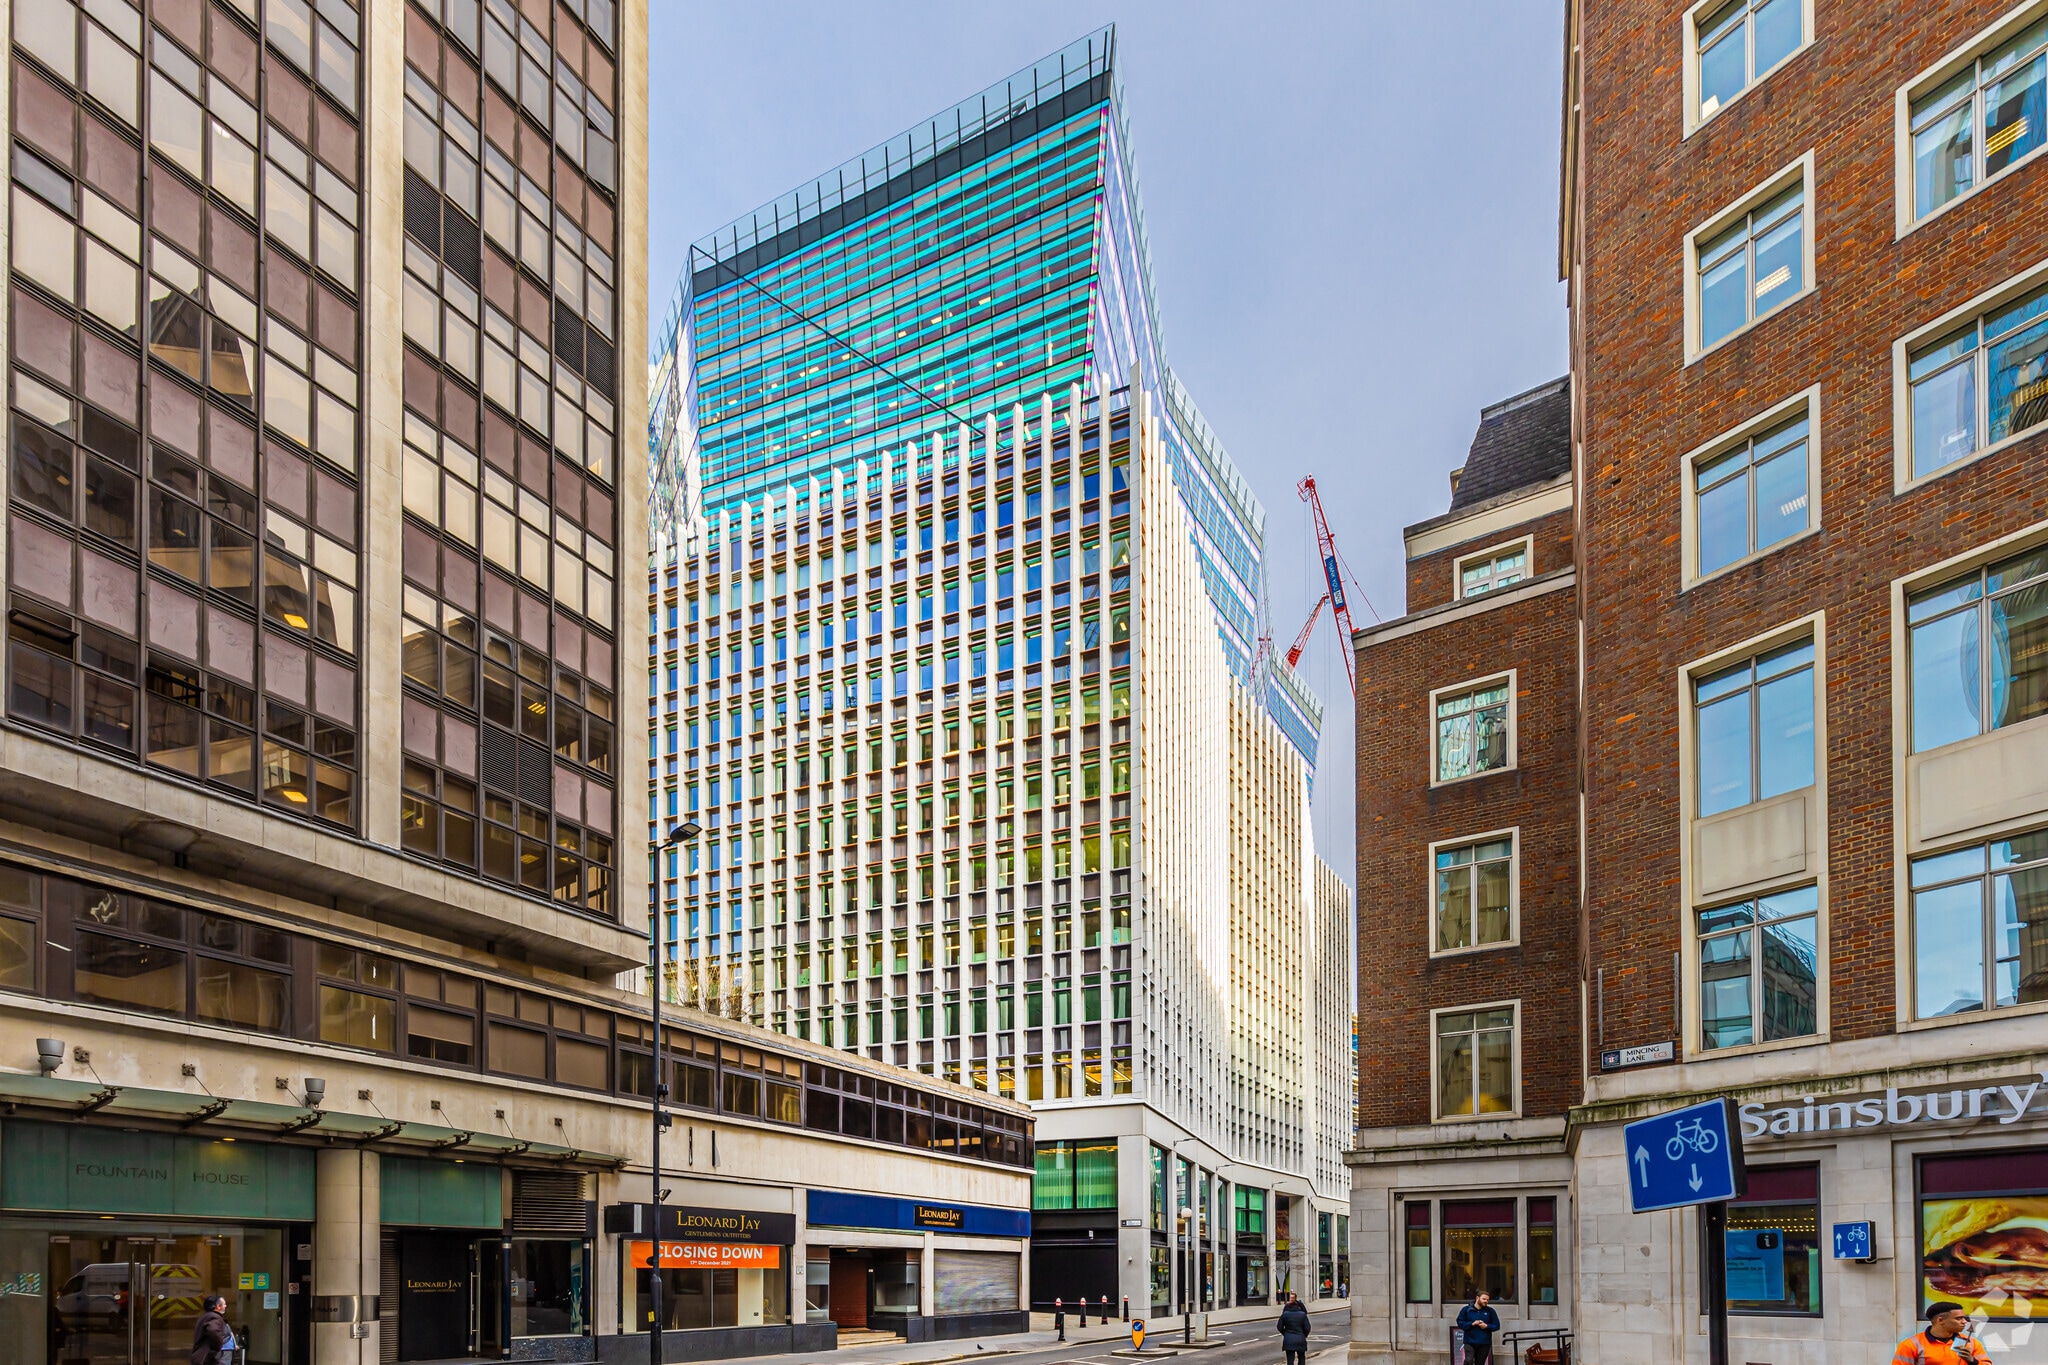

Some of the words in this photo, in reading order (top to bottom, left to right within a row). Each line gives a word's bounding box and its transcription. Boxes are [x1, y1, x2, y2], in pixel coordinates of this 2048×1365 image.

[1626, 1046, 1660, 1056] MINCING
[1626, 1055, 1646, 1063] LANE
[1653, 1051, 1668, 1059] EC3
[76, 1164, 167, 1180] FOUNTAIN
[193, 1172, 249, 1186] HOUSE
[677, 1211, 738, 1229] LEONARD
[739, 1215, 760, 1232] JAY
[722, 1247, 763, 1259] DOWN
[408, 1280, 447, 1288] LEONARD
[448, 1280, 462, 1289] JAY
